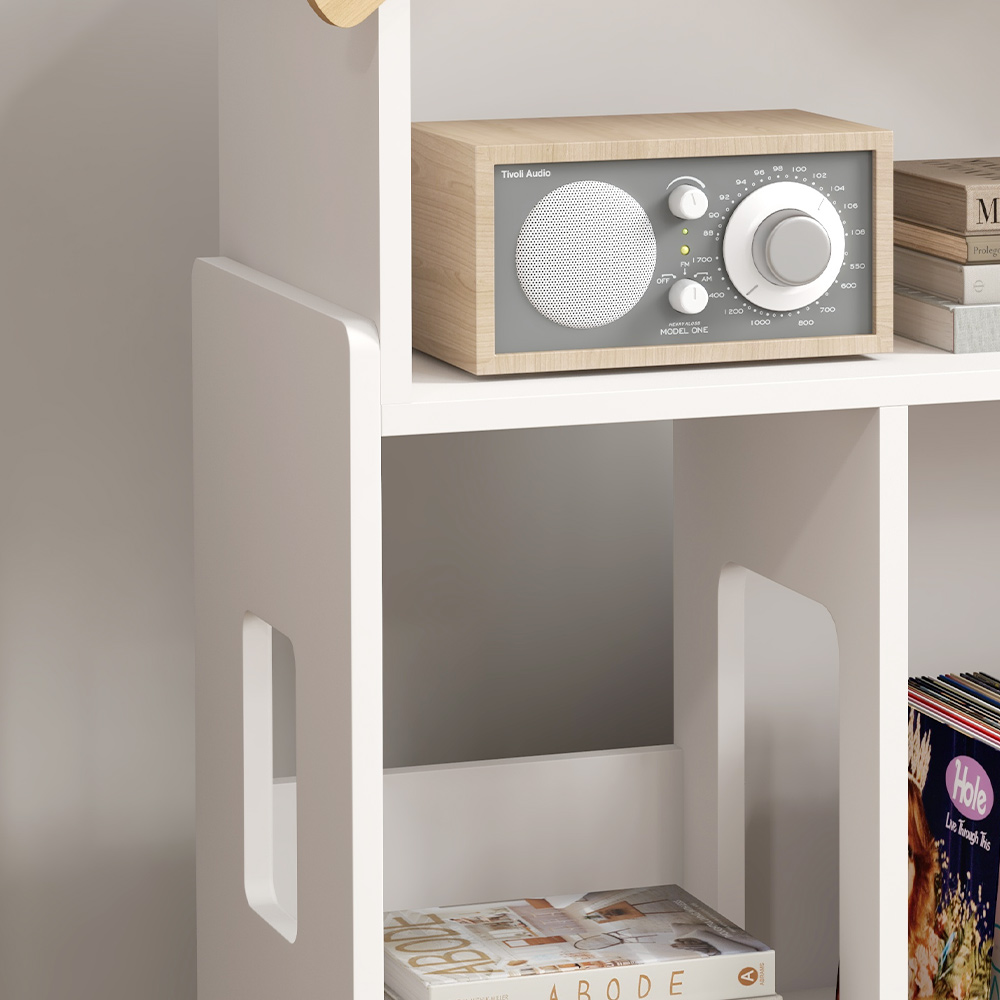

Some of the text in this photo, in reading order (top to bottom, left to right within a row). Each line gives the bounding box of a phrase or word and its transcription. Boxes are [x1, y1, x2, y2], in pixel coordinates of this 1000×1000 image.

[501, 169, 551, 179] Tivoli Audio
[691, 326, 709, 334] ONE
[952, 758, 987, 815] Hole
[945, 811, 991, 852] Live Through This
[384, 913, 504, 975] ABODE
[549, 970, 684, 1000] ABODE
